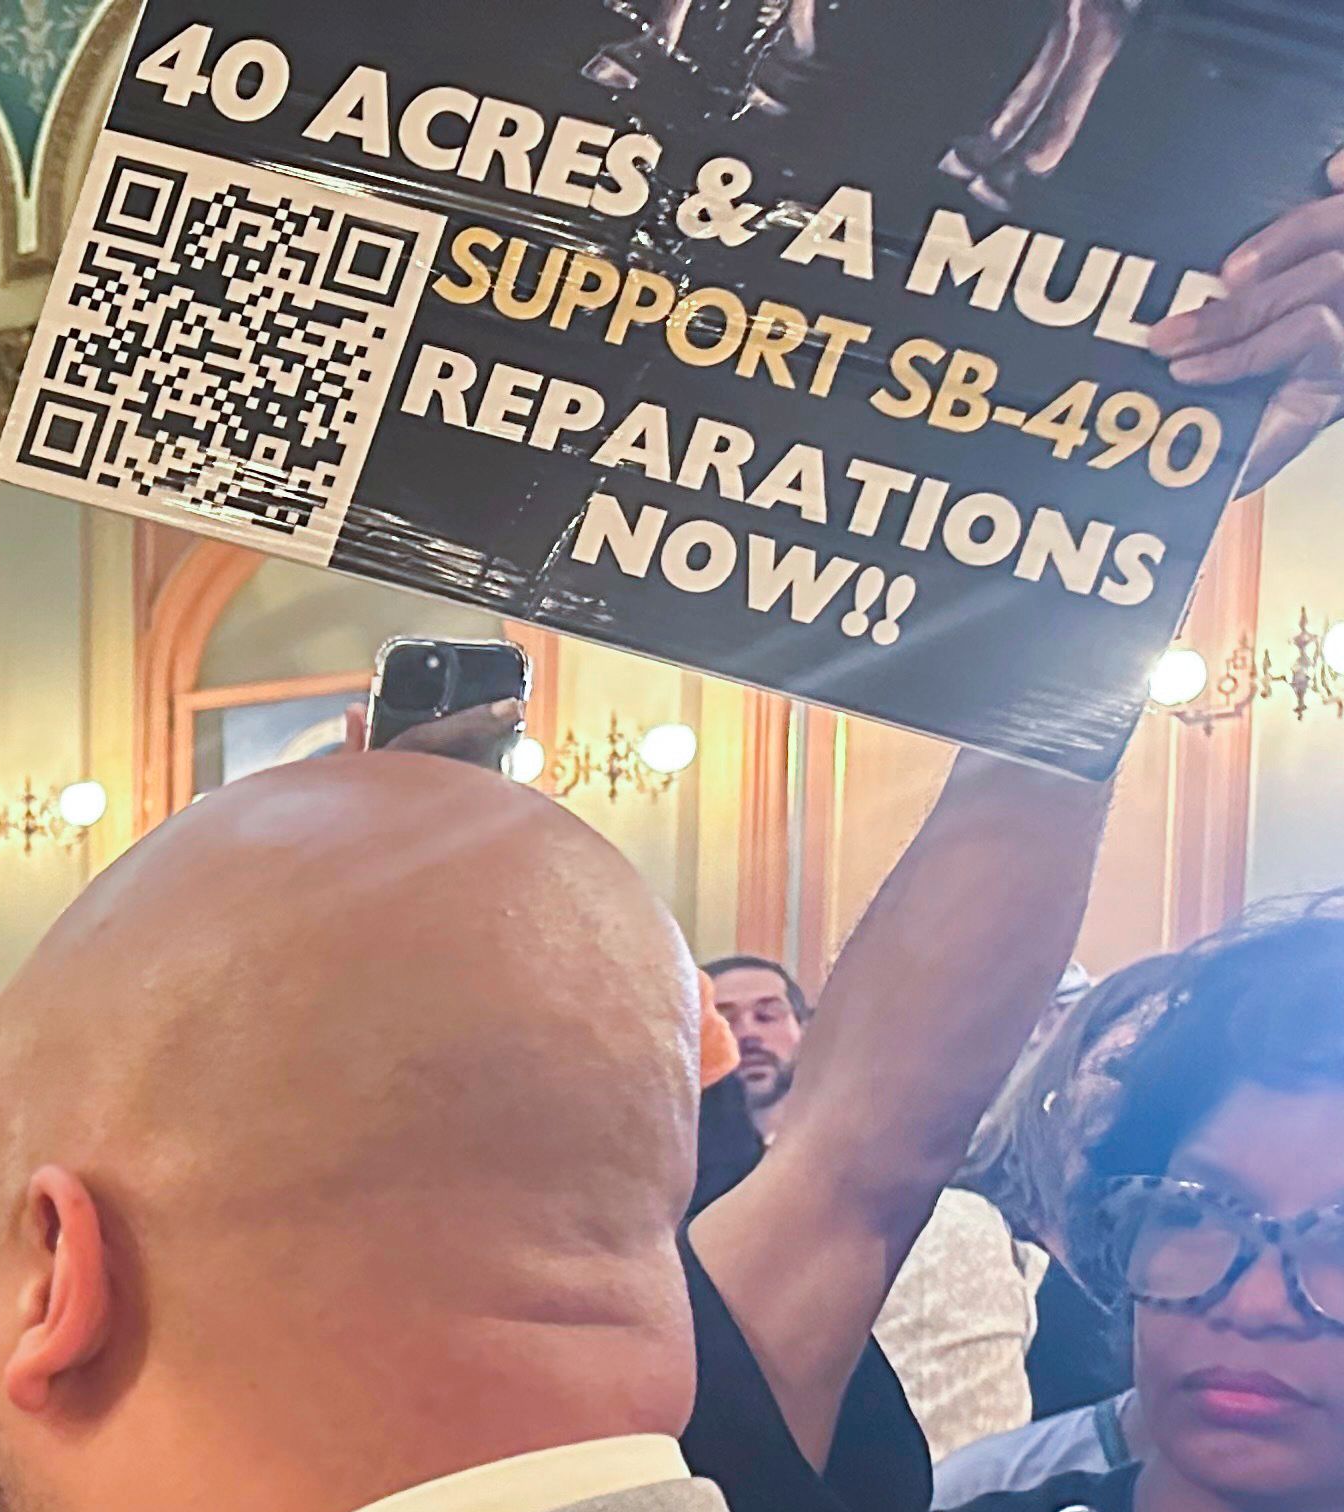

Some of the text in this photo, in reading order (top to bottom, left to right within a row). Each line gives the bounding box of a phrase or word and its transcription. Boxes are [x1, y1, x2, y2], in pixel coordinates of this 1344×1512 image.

[137, 24, 291, 123] 40
[303, 65, 664, 221] ACRES
[676, 155, 768, 248] &
[781, 185, 874, 283] A
[400, 345, 1165, 607] REPARATIONS
[432, 226, 1222, 489] SUPPORT SB-490
[572, 491, 918, 647] NOW!!
